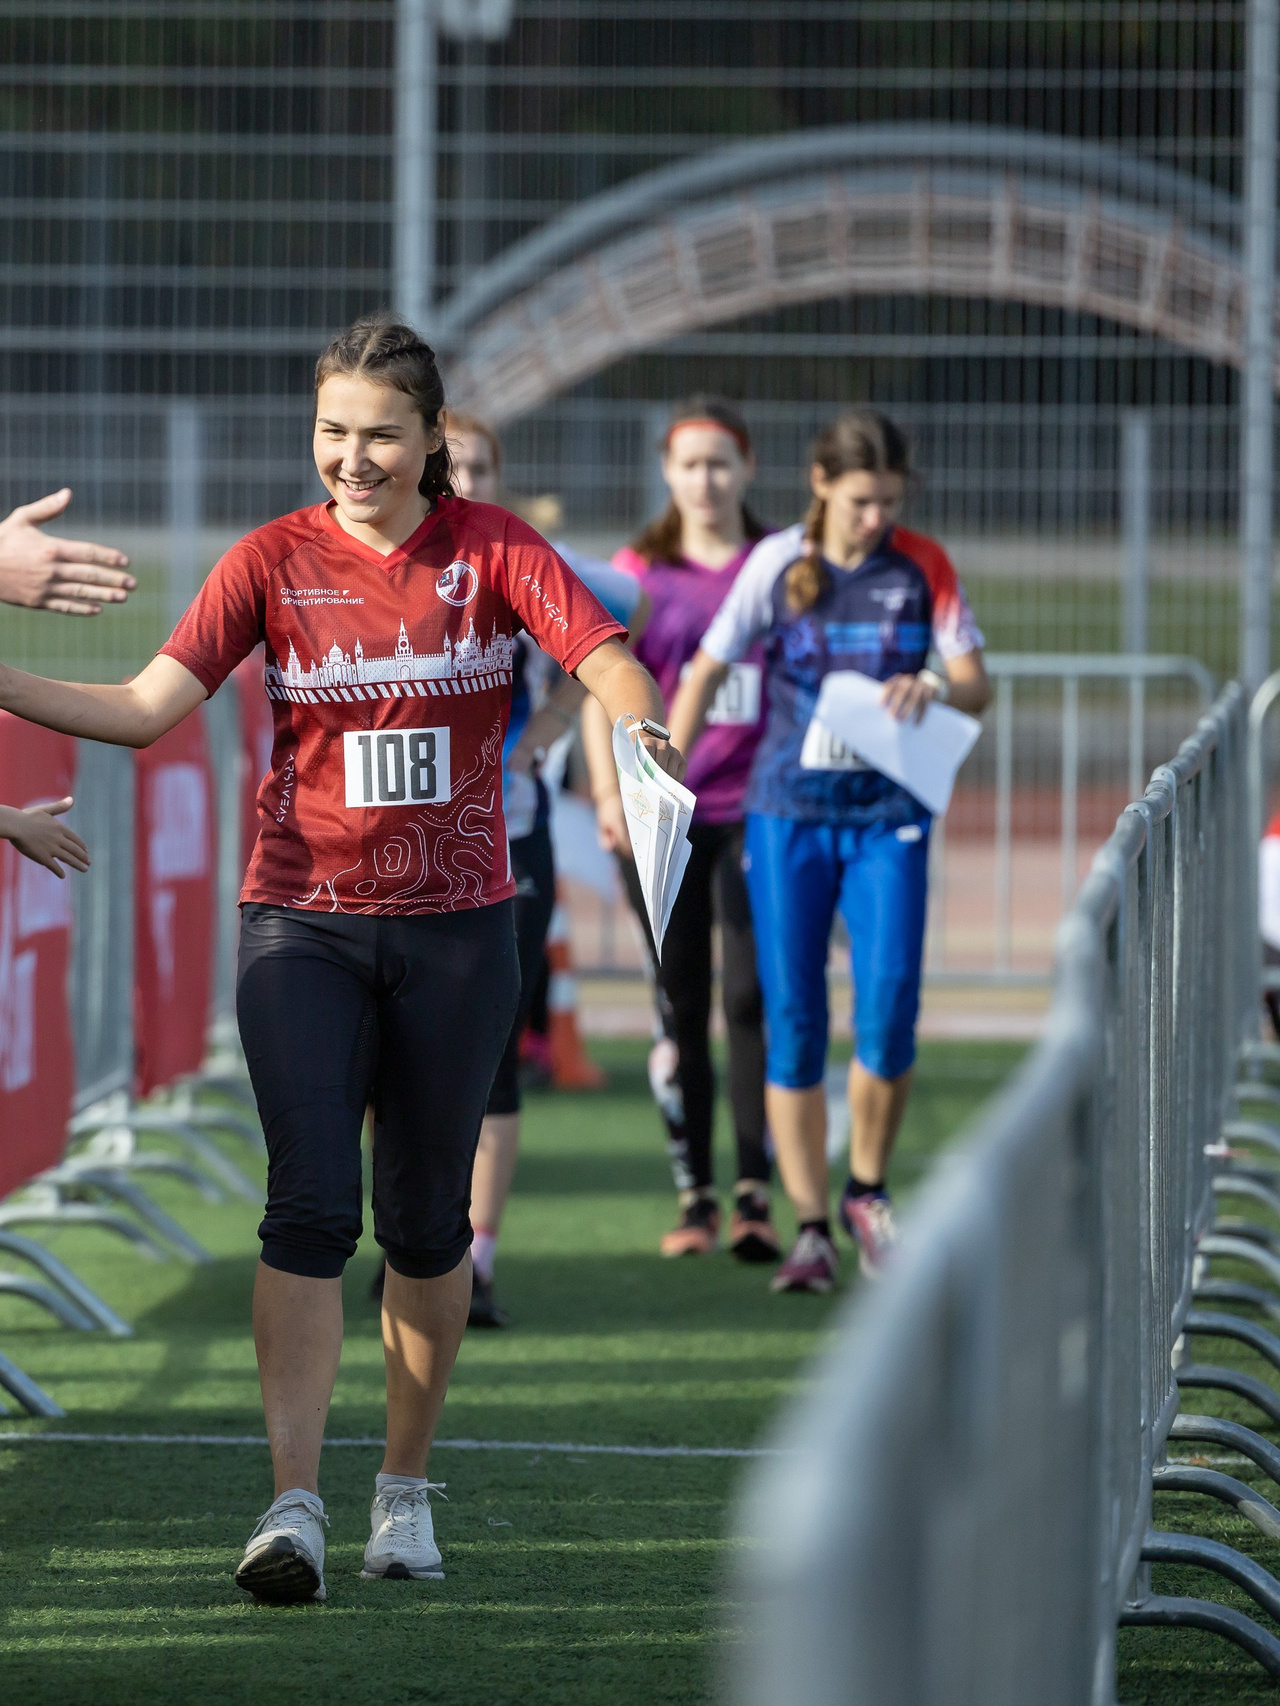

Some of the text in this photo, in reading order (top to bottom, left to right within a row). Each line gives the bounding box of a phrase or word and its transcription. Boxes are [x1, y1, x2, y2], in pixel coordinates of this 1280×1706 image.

[280, 587, 340, 597] СПОРТИВНОЕ
[281, 597, 364, 607] ОРИЕНТИРОВАНИЕ
[357, 731, 437, 802] 108
